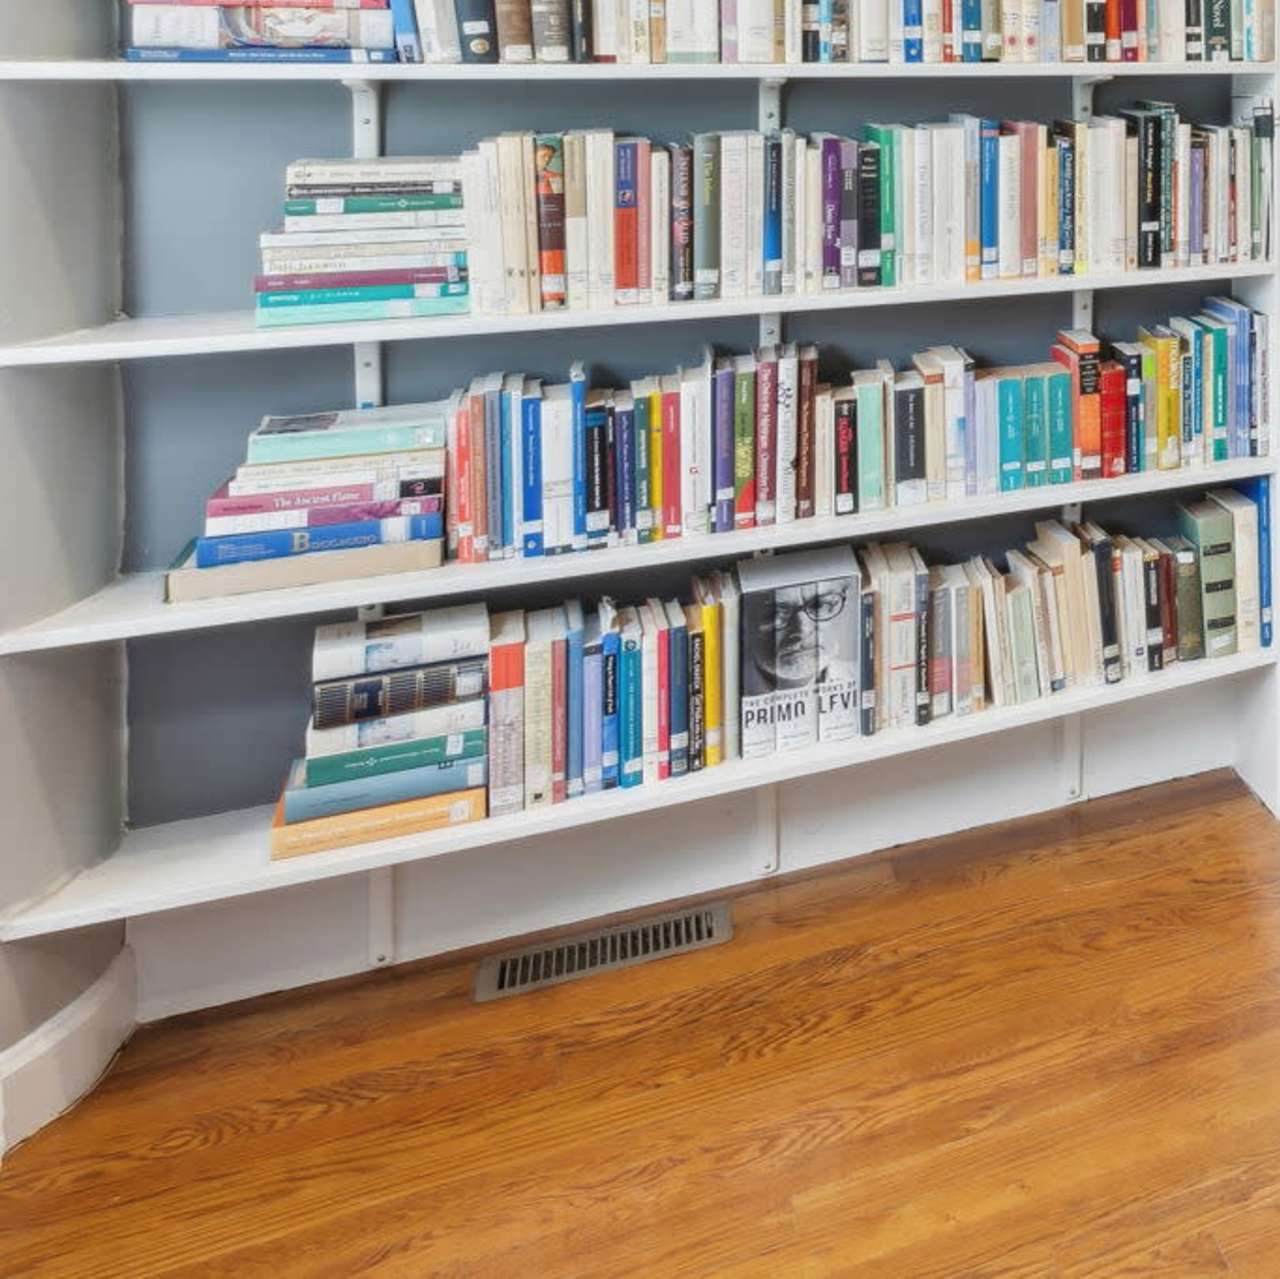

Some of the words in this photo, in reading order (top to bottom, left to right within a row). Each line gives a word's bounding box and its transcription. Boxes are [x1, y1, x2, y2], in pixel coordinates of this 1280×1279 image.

[1211, 0, 1224, 28] Novel
[272, 496, 292, 508] The
[745, 700, 805, 728] PRIMO
